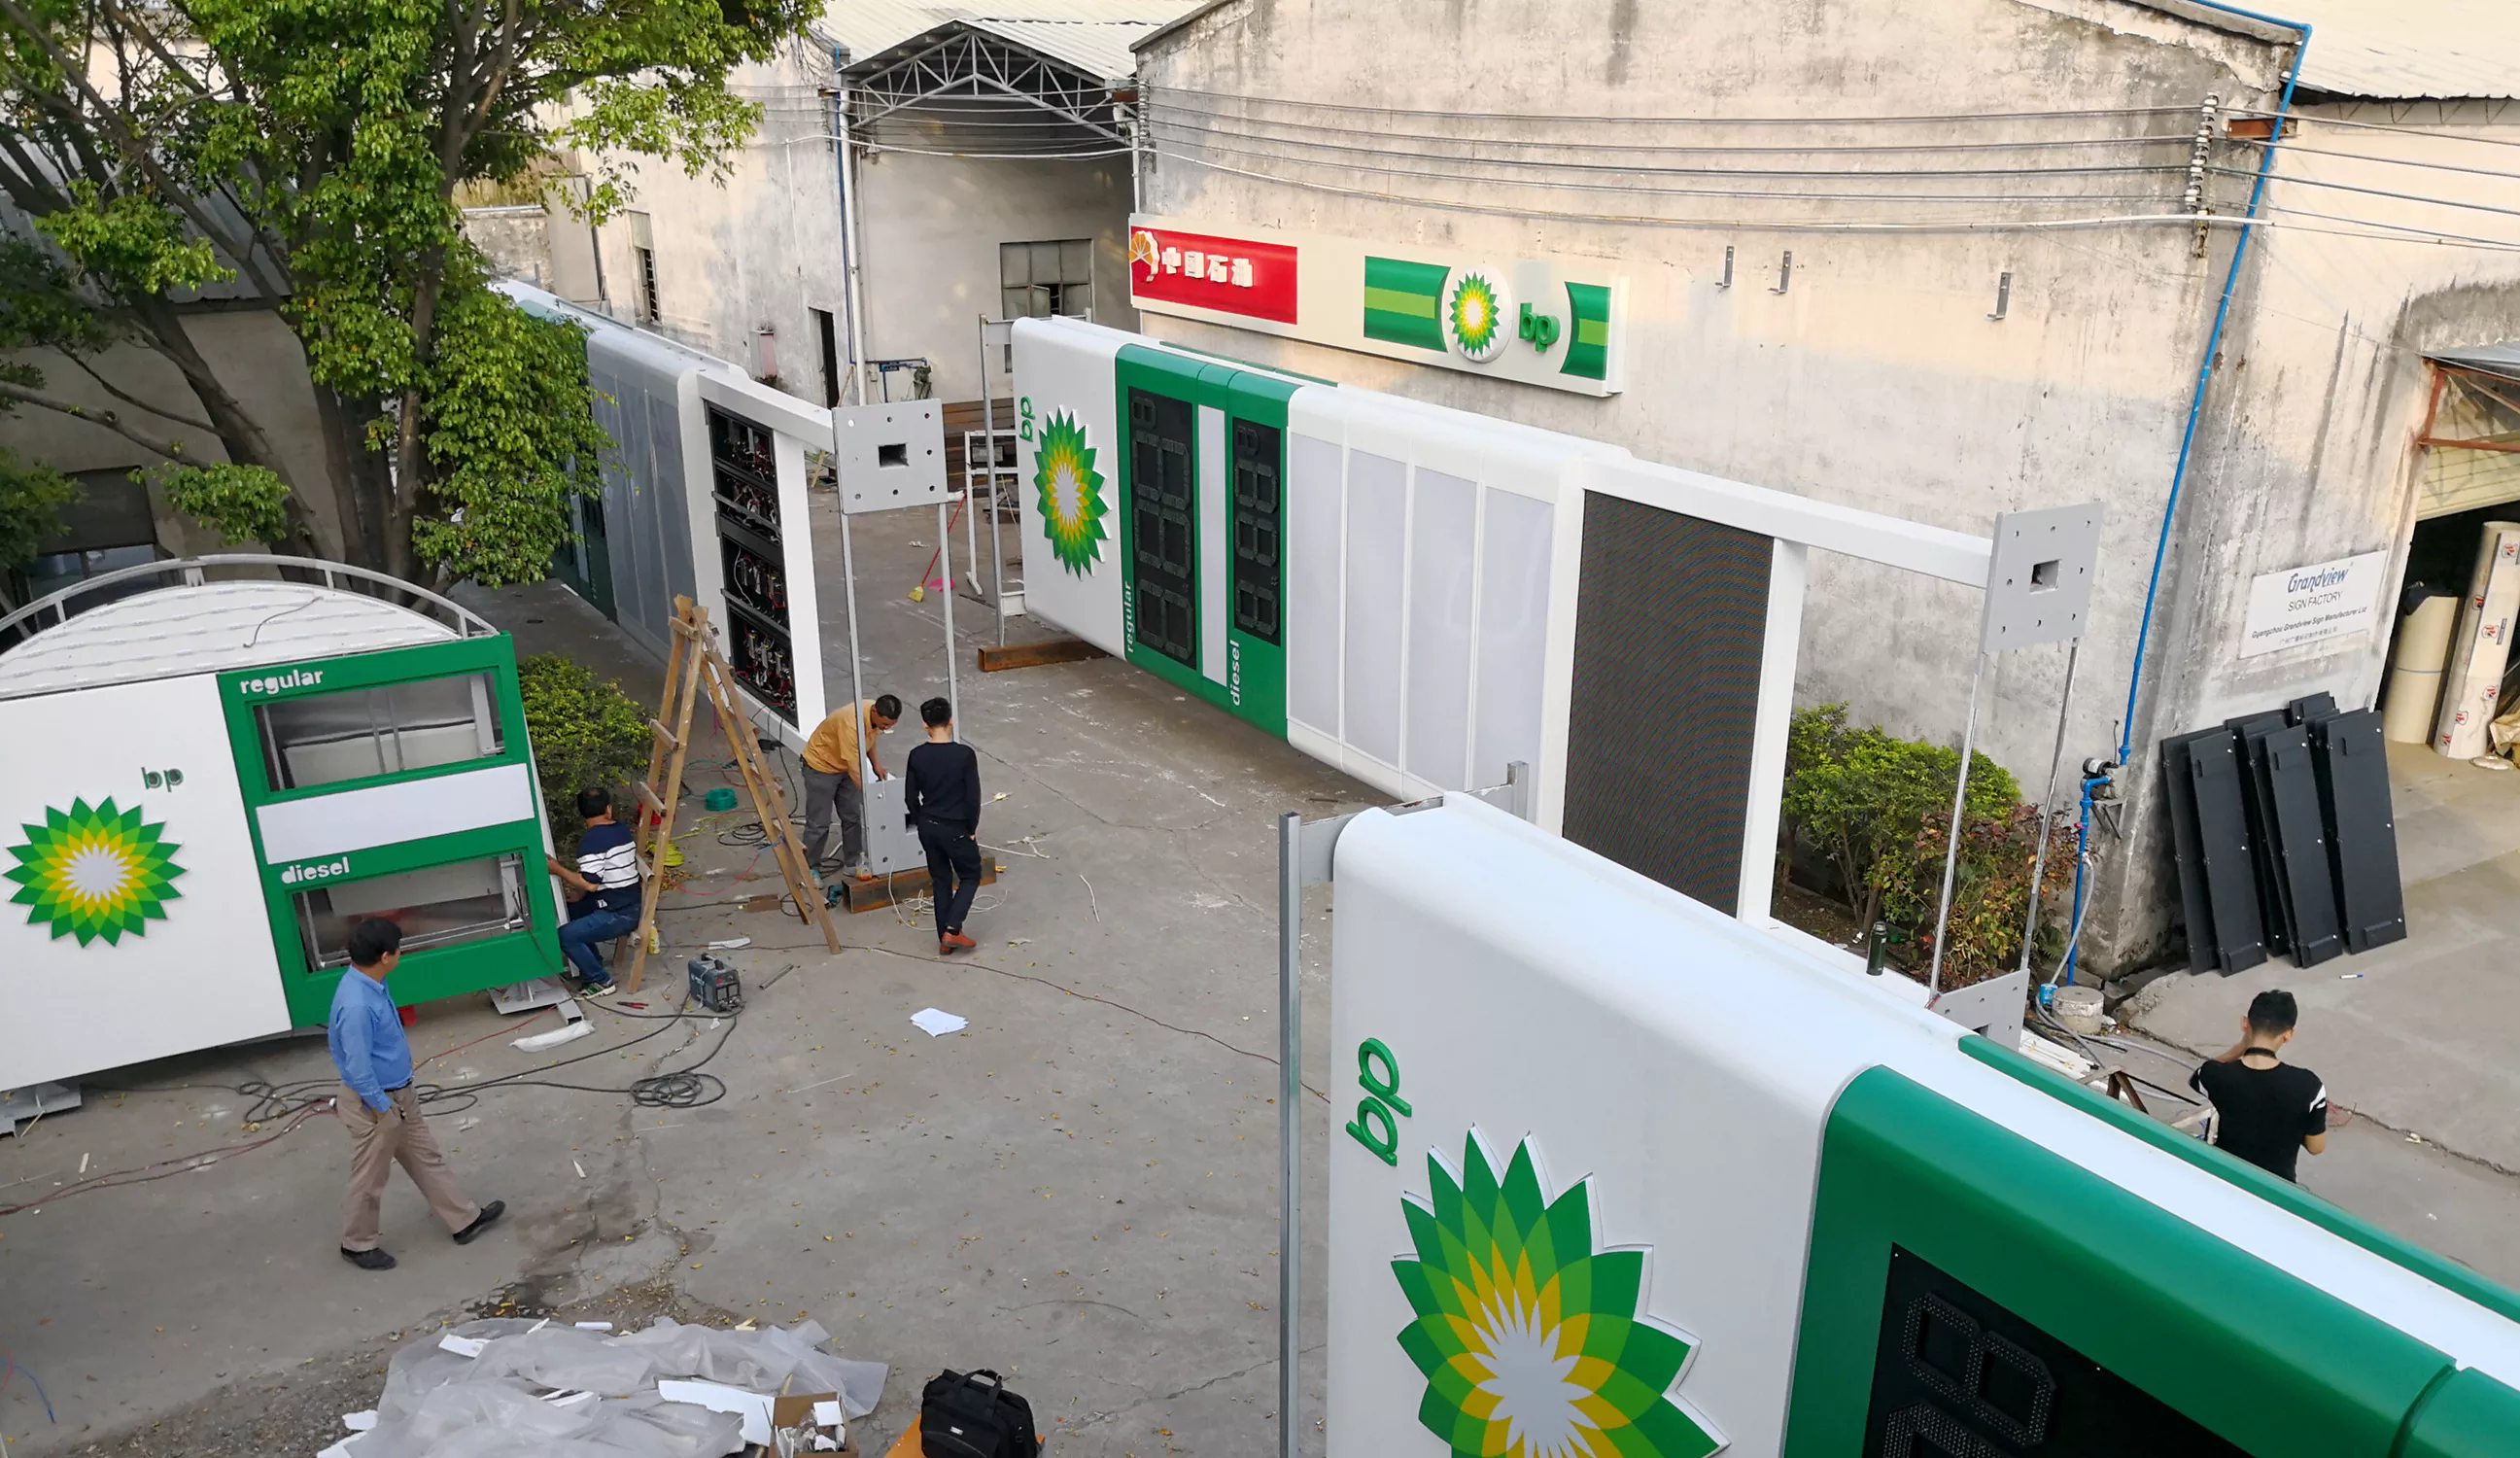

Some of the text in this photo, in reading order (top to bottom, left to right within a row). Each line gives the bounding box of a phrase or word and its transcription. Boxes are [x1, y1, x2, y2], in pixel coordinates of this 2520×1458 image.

[1161, 247, 1253, 287] 中国石油
[1518, 302, 1561, 353] bp
[1020, 397, 1036, 442] bp
[2287, 568, 2349, 593] Grandview
[1123, 580, 1134, 653] regular
[2287, 591, 2341, 611] SIGN FACTORY
[239, 669, 324, 695] regular
[1229, 640, 1242, 707] diesel
[141, 766, 184, 793] bp
[281, 856, 351, 885] diesel
[1345, 1037, 1412, 1166] bp
